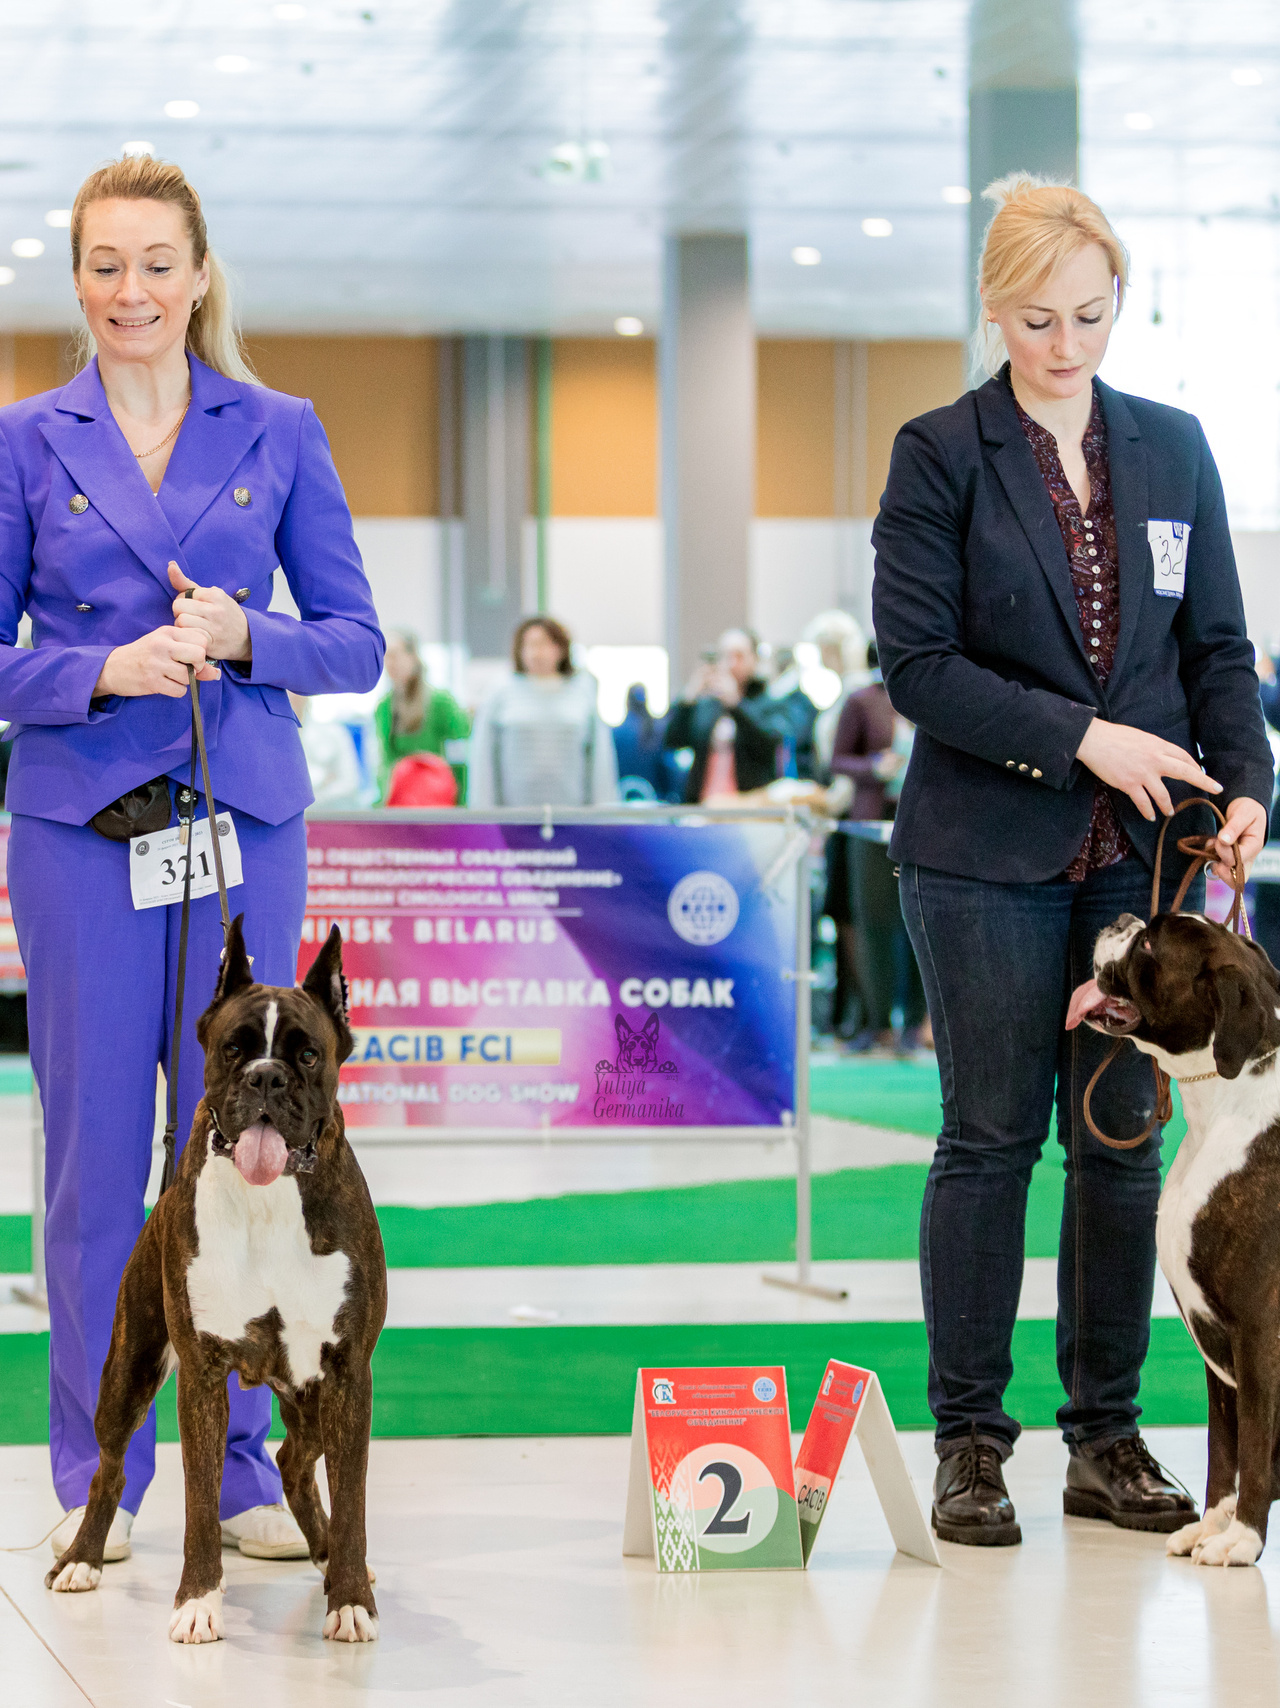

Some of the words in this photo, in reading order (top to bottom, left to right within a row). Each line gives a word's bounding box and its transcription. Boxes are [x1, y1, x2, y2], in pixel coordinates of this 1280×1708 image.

[160, 851, 212, 885] 321
[414, 917, 556, 944] BELARUS
[429, 977, 612, 1008] ВЫСТАВКА
[620, 977, 735, 1009] СОБАК
[460, 1034, 512, 1063] FCI
[447, 1082, 501, 1103] DOG
[509, 1082, 579, 1104] SHOW
[697, 1461, 751, 1535] 2
[798, 1484, 825, 1511] CACIB
